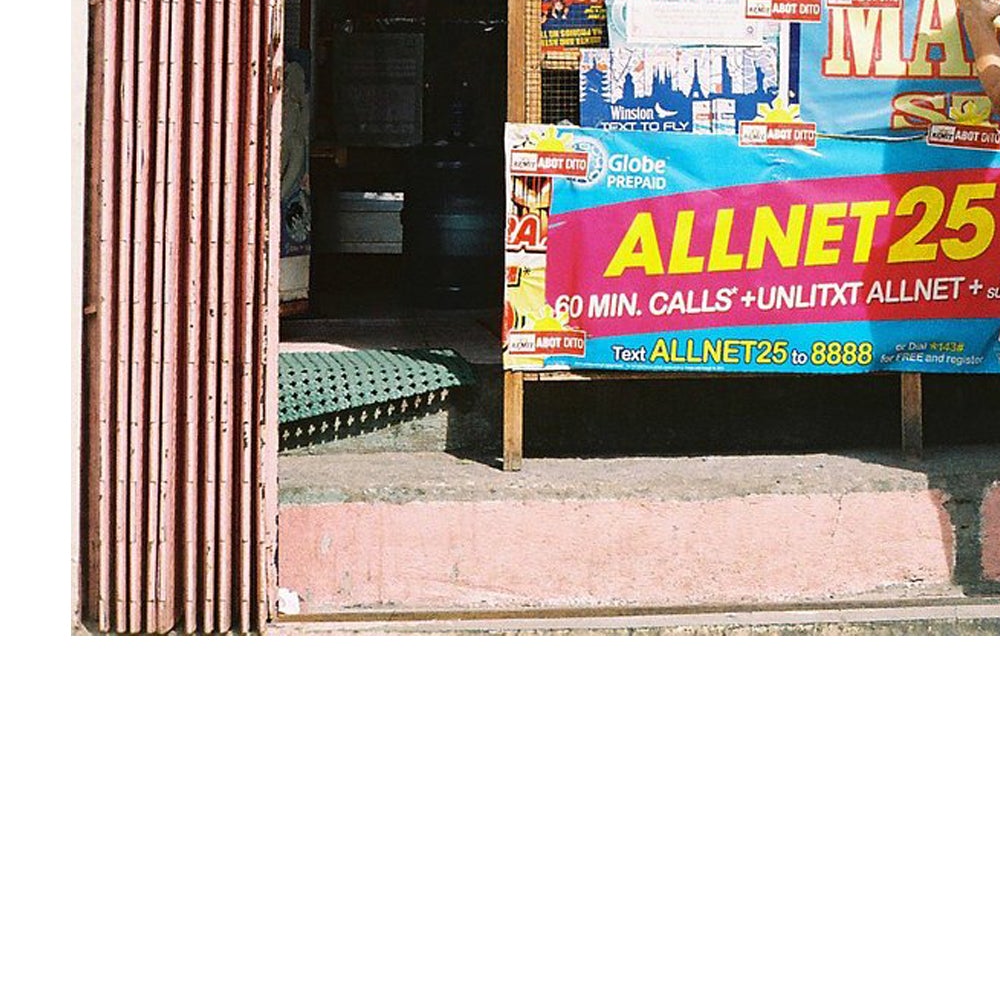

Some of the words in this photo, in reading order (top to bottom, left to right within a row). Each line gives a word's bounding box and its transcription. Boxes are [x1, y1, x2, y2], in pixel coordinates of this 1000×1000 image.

[772, 2, 797, 13] ABOT
[799, 3, 820, 15] DITO
[610, 105, 655, 120] Winston
[601, 122, 637, 131] TEXT
[640, 122, 660, 131] TO
[663, 122, 690, 131] FLY
[767, 128, 793, 140] ABOT
[794, 129, 815, 141] DITO
[955, 130, 980, 141] ABOT
[980, 132, 1000, 144] DITO
[538, 157, 564, 169] ABOT
[565, 158, 587, 170] DITO
[609, 154, 666, 173] Globe
[607, 176, 667, 190] PREPAID
[554, 294, 584, 319] 60
[587, 292, 643, 319] MIN.
[866, 276, 966, 305] ALLNET
[536, 336, 562, 349] ABOT
[563, 337, 585, 349] DITO
[612, 346, 646, 362] Text
[649, 337, 788, 364] ALLNET25
[791, 349, 808, 365] to
[811, 341, 873, 365] 8888
[895, 352, 924, 363] FREE
[925, 353, 945, 364] and
[946, 355, 984, 367] register
